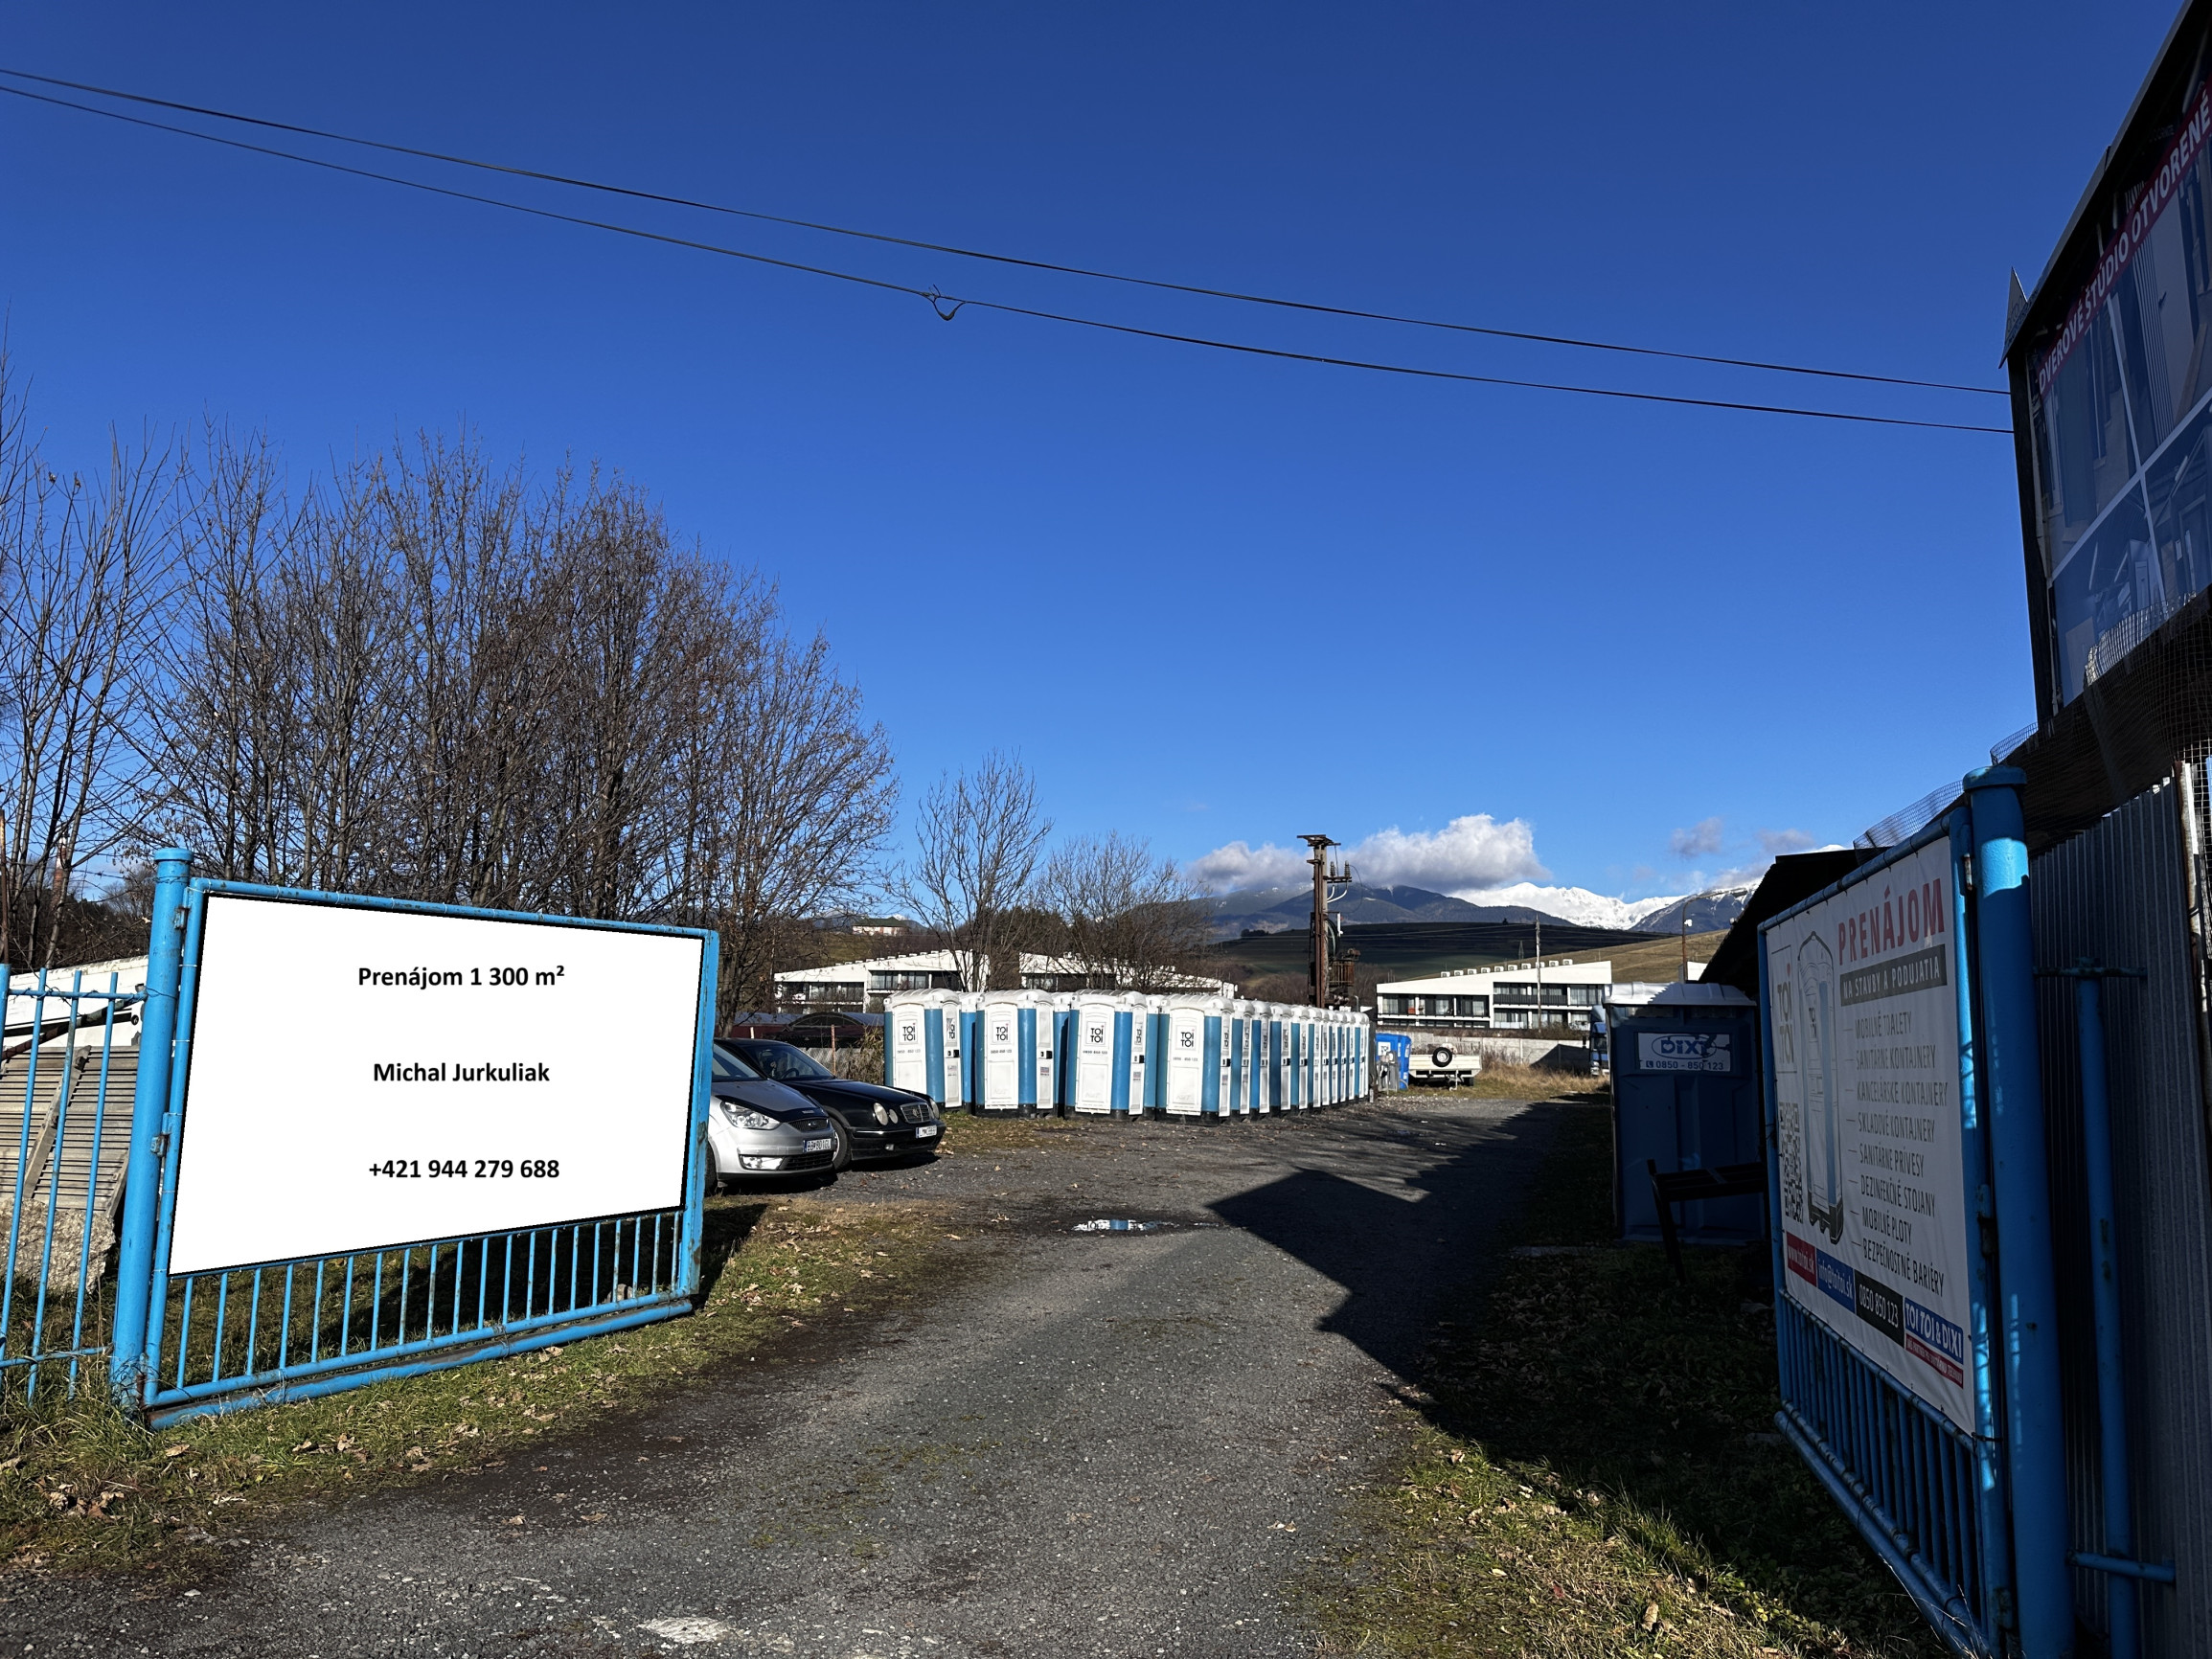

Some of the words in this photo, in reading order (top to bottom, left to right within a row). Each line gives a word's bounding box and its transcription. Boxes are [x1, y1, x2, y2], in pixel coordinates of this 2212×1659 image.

[2039, 298, 2085, 392] DVEROVÉ
[2084, 231, 2129, 317] ŠTÚDIO
[2132, 88, 2211, 242] OTVORENÉ
[1838, 878, 1945, 966] PRENÁJOM
[1843, 981, 1853, 999] NA
[1855, 971, 1881, 997] STAVBY
[1883, 970, 1888, 989] A
[1892, 956, 1940, 989] PODUJATIA
[1856, 1011, 1882, 1039] MOBILNÉ
[1883, 1011, 1911, 1035] TOALETY
[1656, 1060, 1678, 1069] 0850
[1687, 1061, 1703, 1070] 850
[1890, 1045, 1935, 1070] KONTAJNERY
[1902, 1081, 1948, 1106] KONTAJNERY
[1859, 1109, 1889, 1136] SKLADOVÉ
[1890, 1115, 1935, 1143] KONTAJNERY
[1895, 1147, 1924, 1177] PRÍVESY
[1860, 1174, 1902, 1207] DEZINFEKČNÉ
[1904, 1187, 1935, 1217] STOJANY
[1862, 1206, 1891, 1237] MOBILNÉ
[1892, 1216, 1912, 1245] PLOTY
[1862, 1238, 1911, 1281] BEZPEČNOSTNÉ
[1913, 1260, 1944, 1297] BARIÉRY
[1859, 1284, 1874, 1313] 0850
[1875, 1292, 1886, 1320] 850
[1886, 1301, 1899, 1329] 123
[1905, 1303, 1918, 1332] TOI
[1920, 1311, 1935, 1342] TOI
[1935, 1321, 1942, 1345] &
[1942, 1323, 1962, 1358] DIXI
